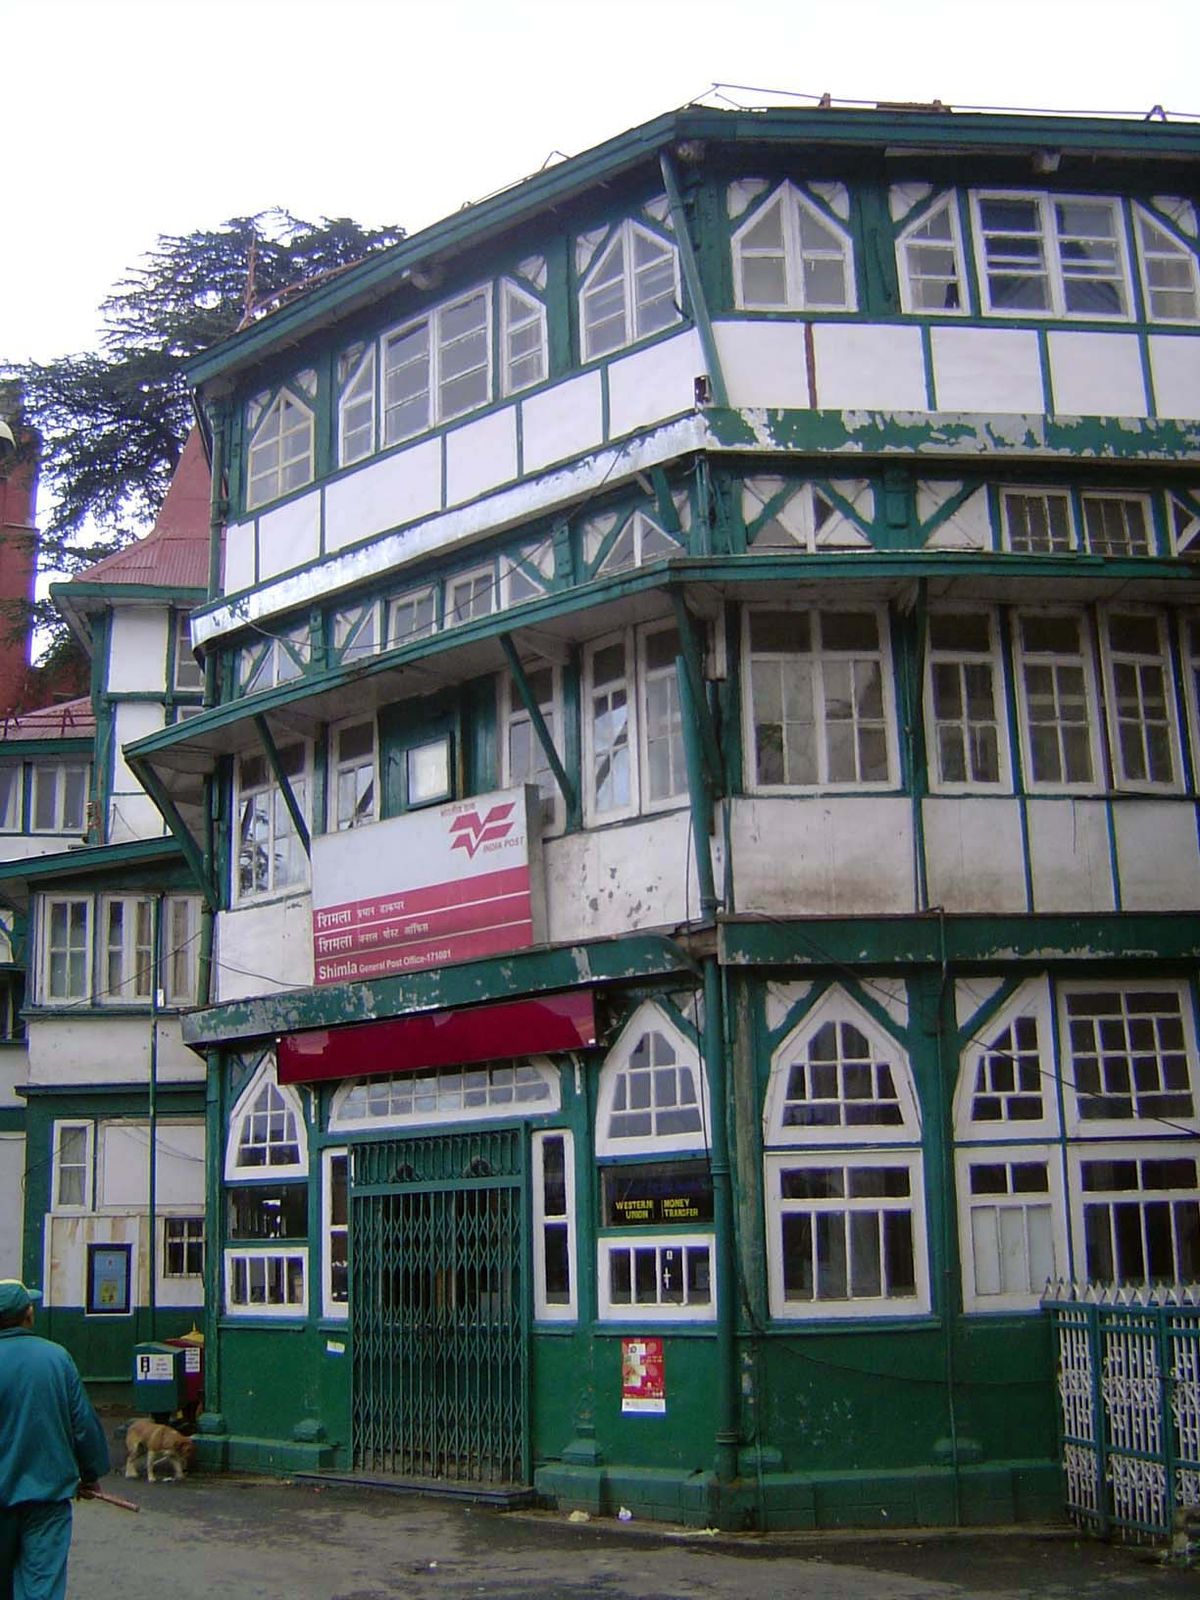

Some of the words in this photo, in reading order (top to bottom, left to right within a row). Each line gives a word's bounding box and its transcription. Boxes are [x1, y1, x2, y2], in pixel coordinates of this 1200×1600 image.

[484, 841, 502, 852] INDIA
[504, 836, 525, 848] POST
[317, 910, 351, 928] शिमला
[318, 935, 352, 953] शिमला
[383, 927, 399, 939] पोस्ट
[319, 961, 357, 980] Shimla
[359, 960, 385, 972] General
[386, 958, 402, 969] Post
[615, 1199, 653, 1210] WESTERN
[663, 1198, 690, 1208] MONEY
[625, 1210, 648, 1219] UNION
[664, 1208, 698, 1217] TRANSFER
